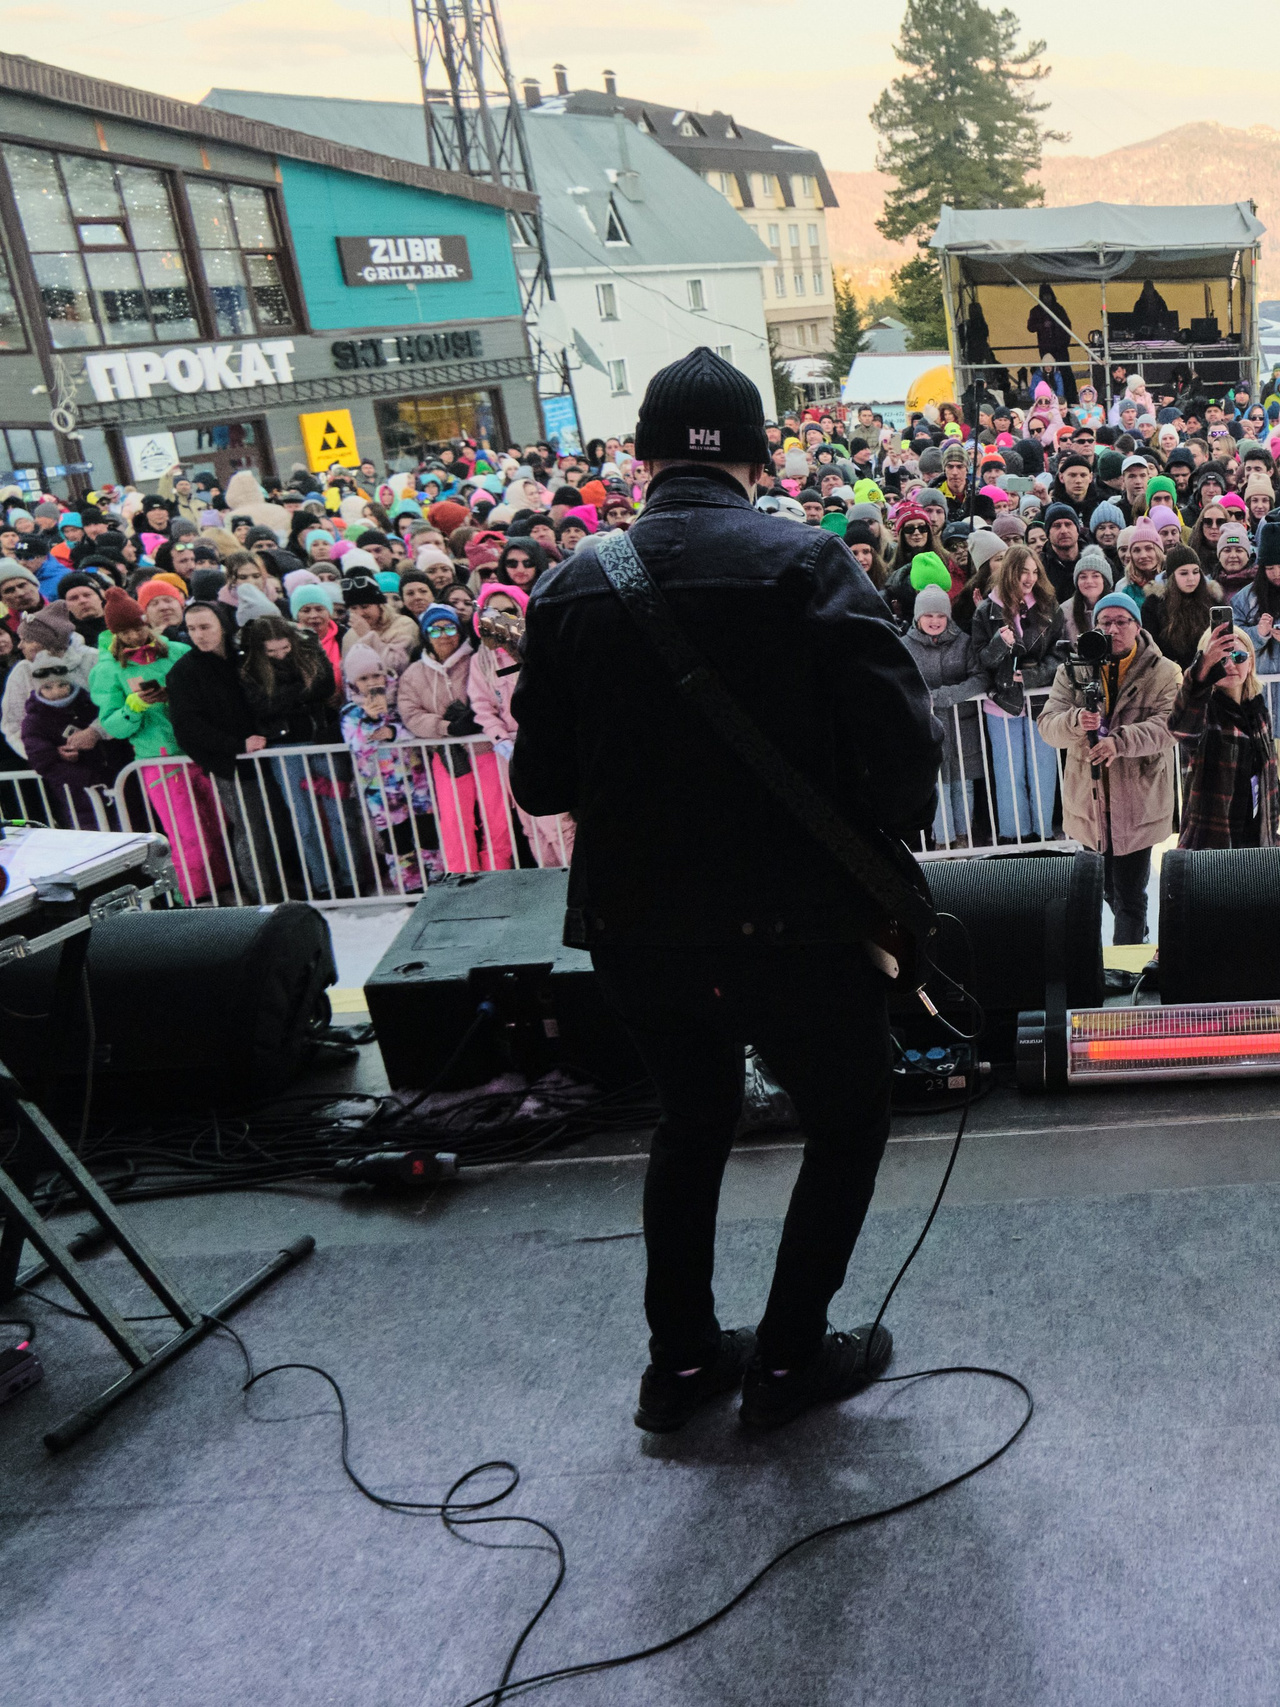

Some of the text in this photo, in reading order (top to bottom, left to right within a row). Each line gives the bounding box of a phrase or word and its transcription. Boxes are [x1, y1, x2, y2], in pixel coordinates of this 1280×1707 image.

[368, 238, 444, 264] ZUBR
[86, 340, 295, 402] ПРОКАТ
[331, 330, 483, 371] SKI HOUSE
